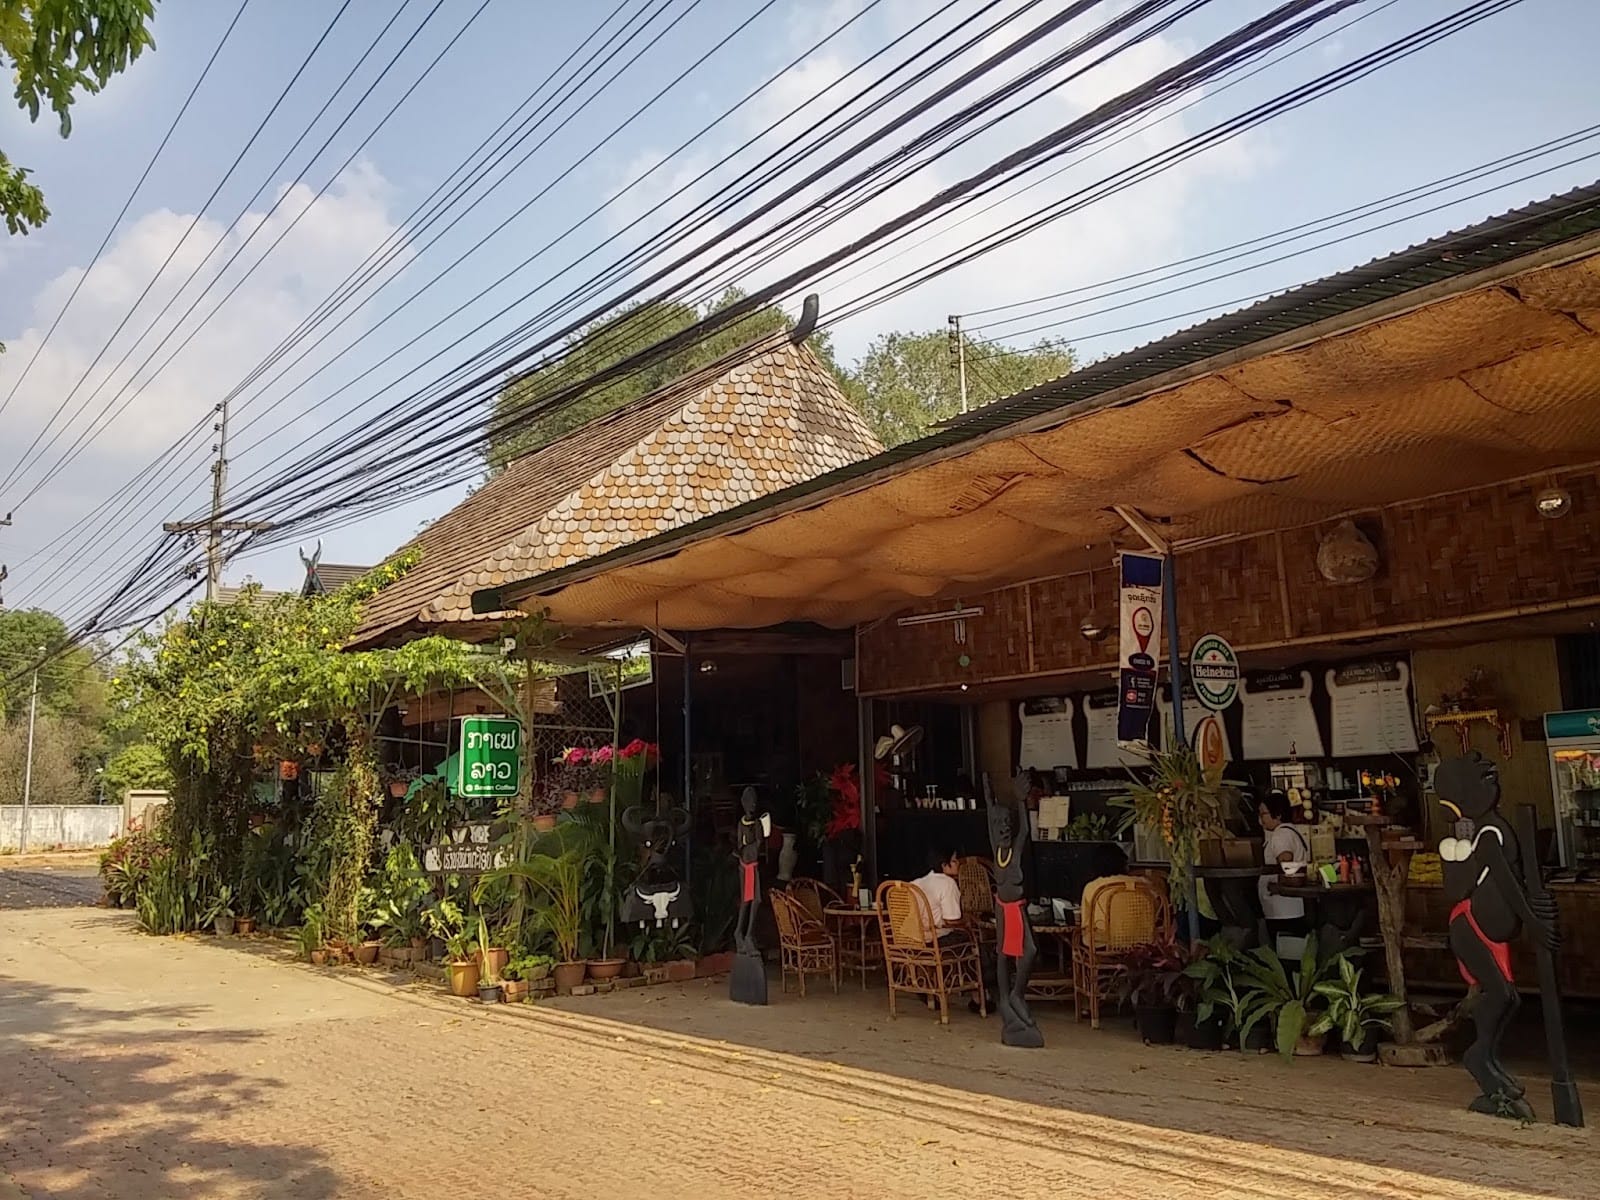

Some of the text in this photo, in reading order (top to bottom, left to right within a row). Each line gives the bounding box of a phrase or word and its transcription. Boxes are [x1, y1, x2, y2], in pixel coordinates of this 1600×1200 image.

[1195, 665, 1235, 678] Heineken
[467, 730, 516, 749] ກາເຟ
[471, 761, 511, 779] ລາວ
